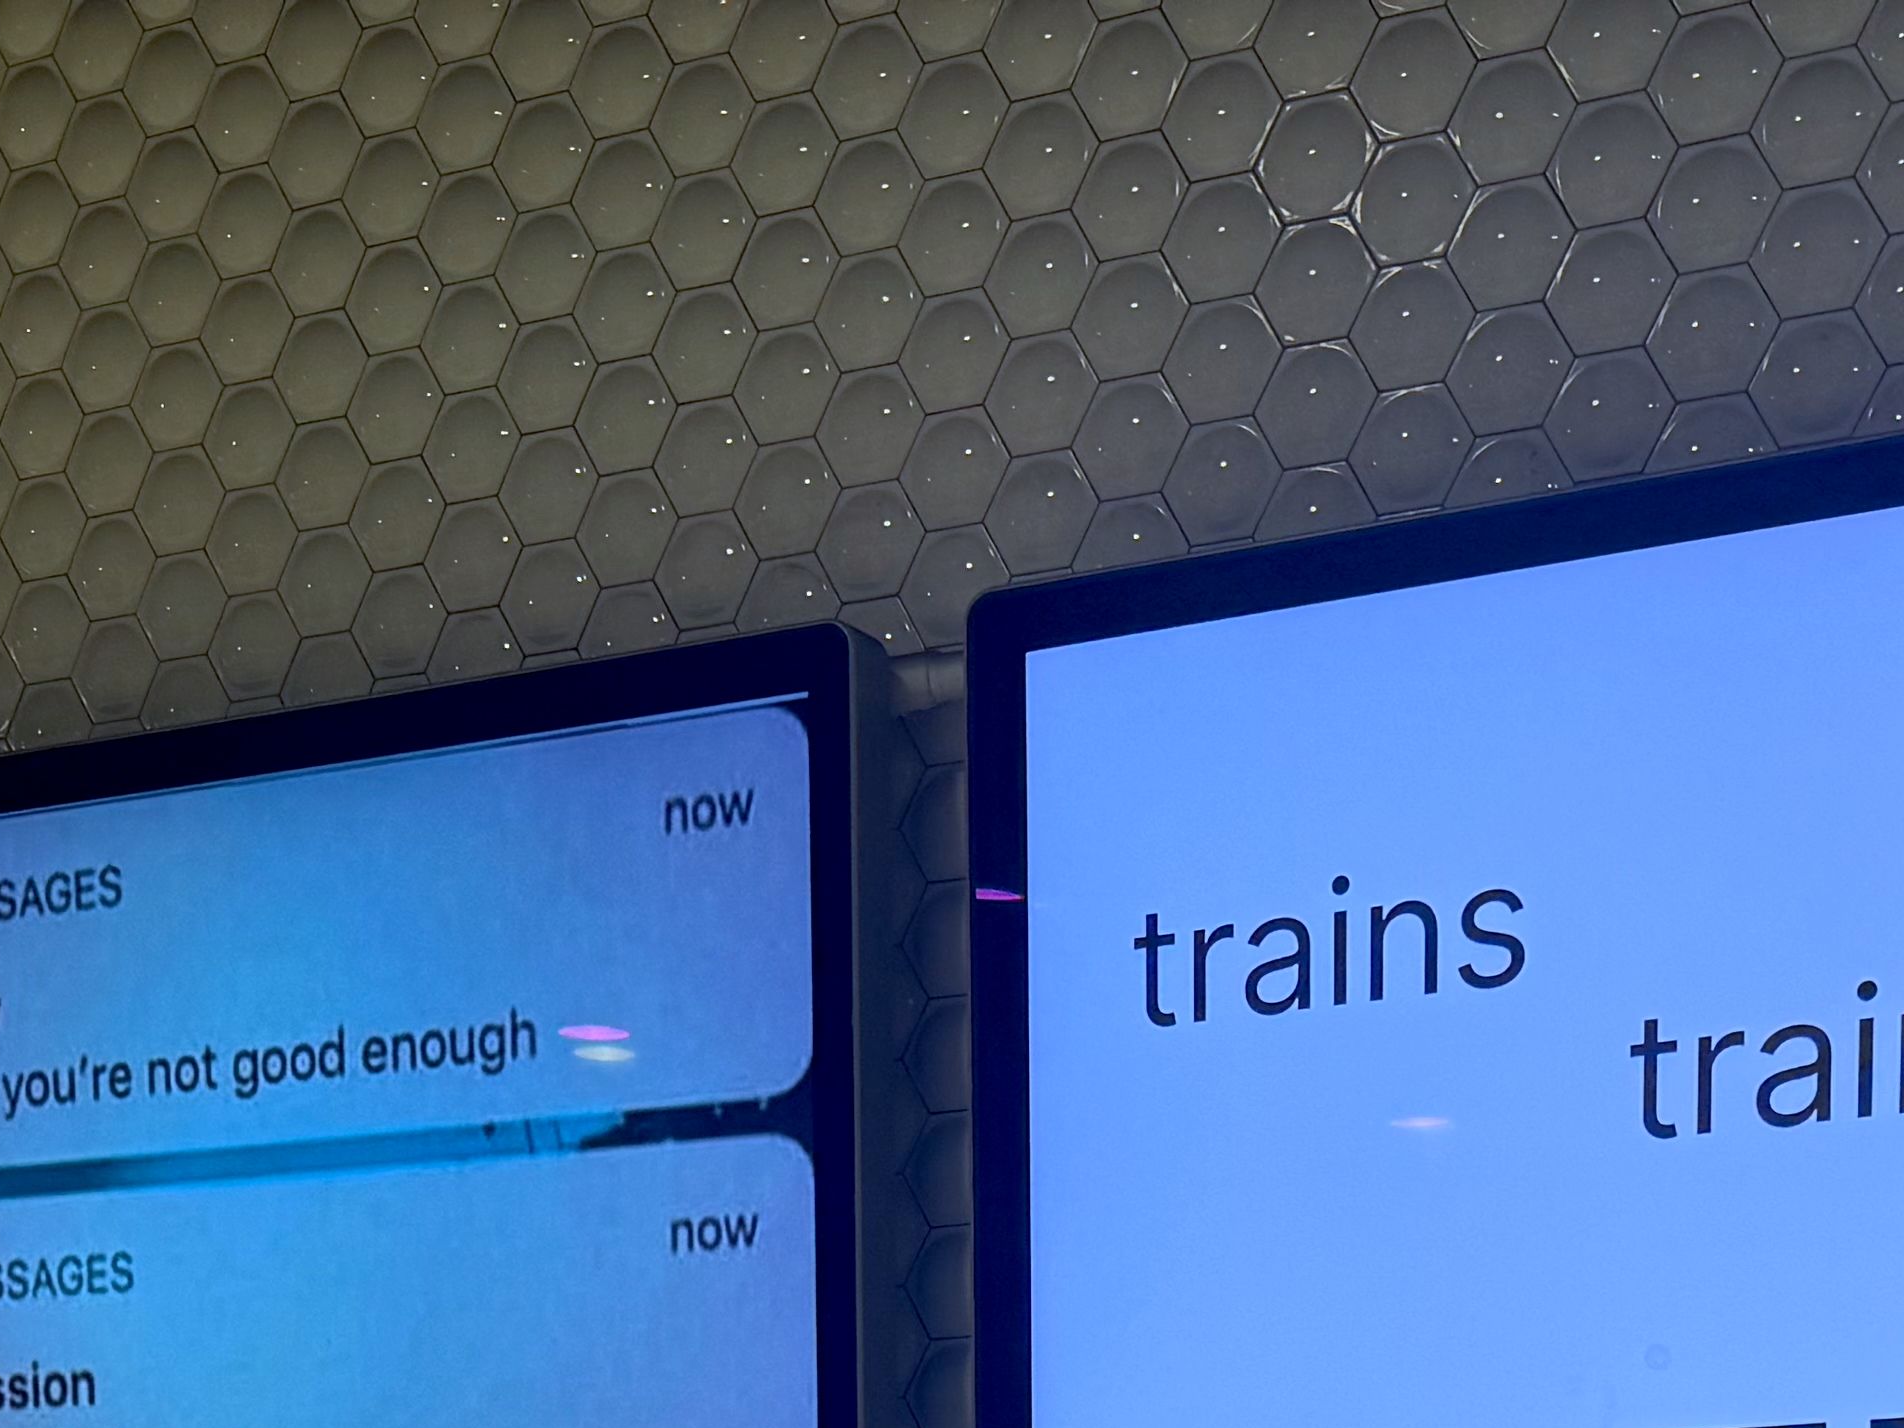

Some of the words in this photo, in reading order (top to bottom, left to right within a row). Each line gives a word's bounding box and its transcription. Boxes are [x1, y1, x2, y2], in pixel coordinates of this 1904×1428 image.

[666, 789, 753, 833] now
[1134, 876, 1524, 1026] trains
[149, 1047, 217, 1094] not
[232, 1022, 348, 1100] good
[363, 1009, 536, 1075] enough
[672, 1215, 757, 1252] now
